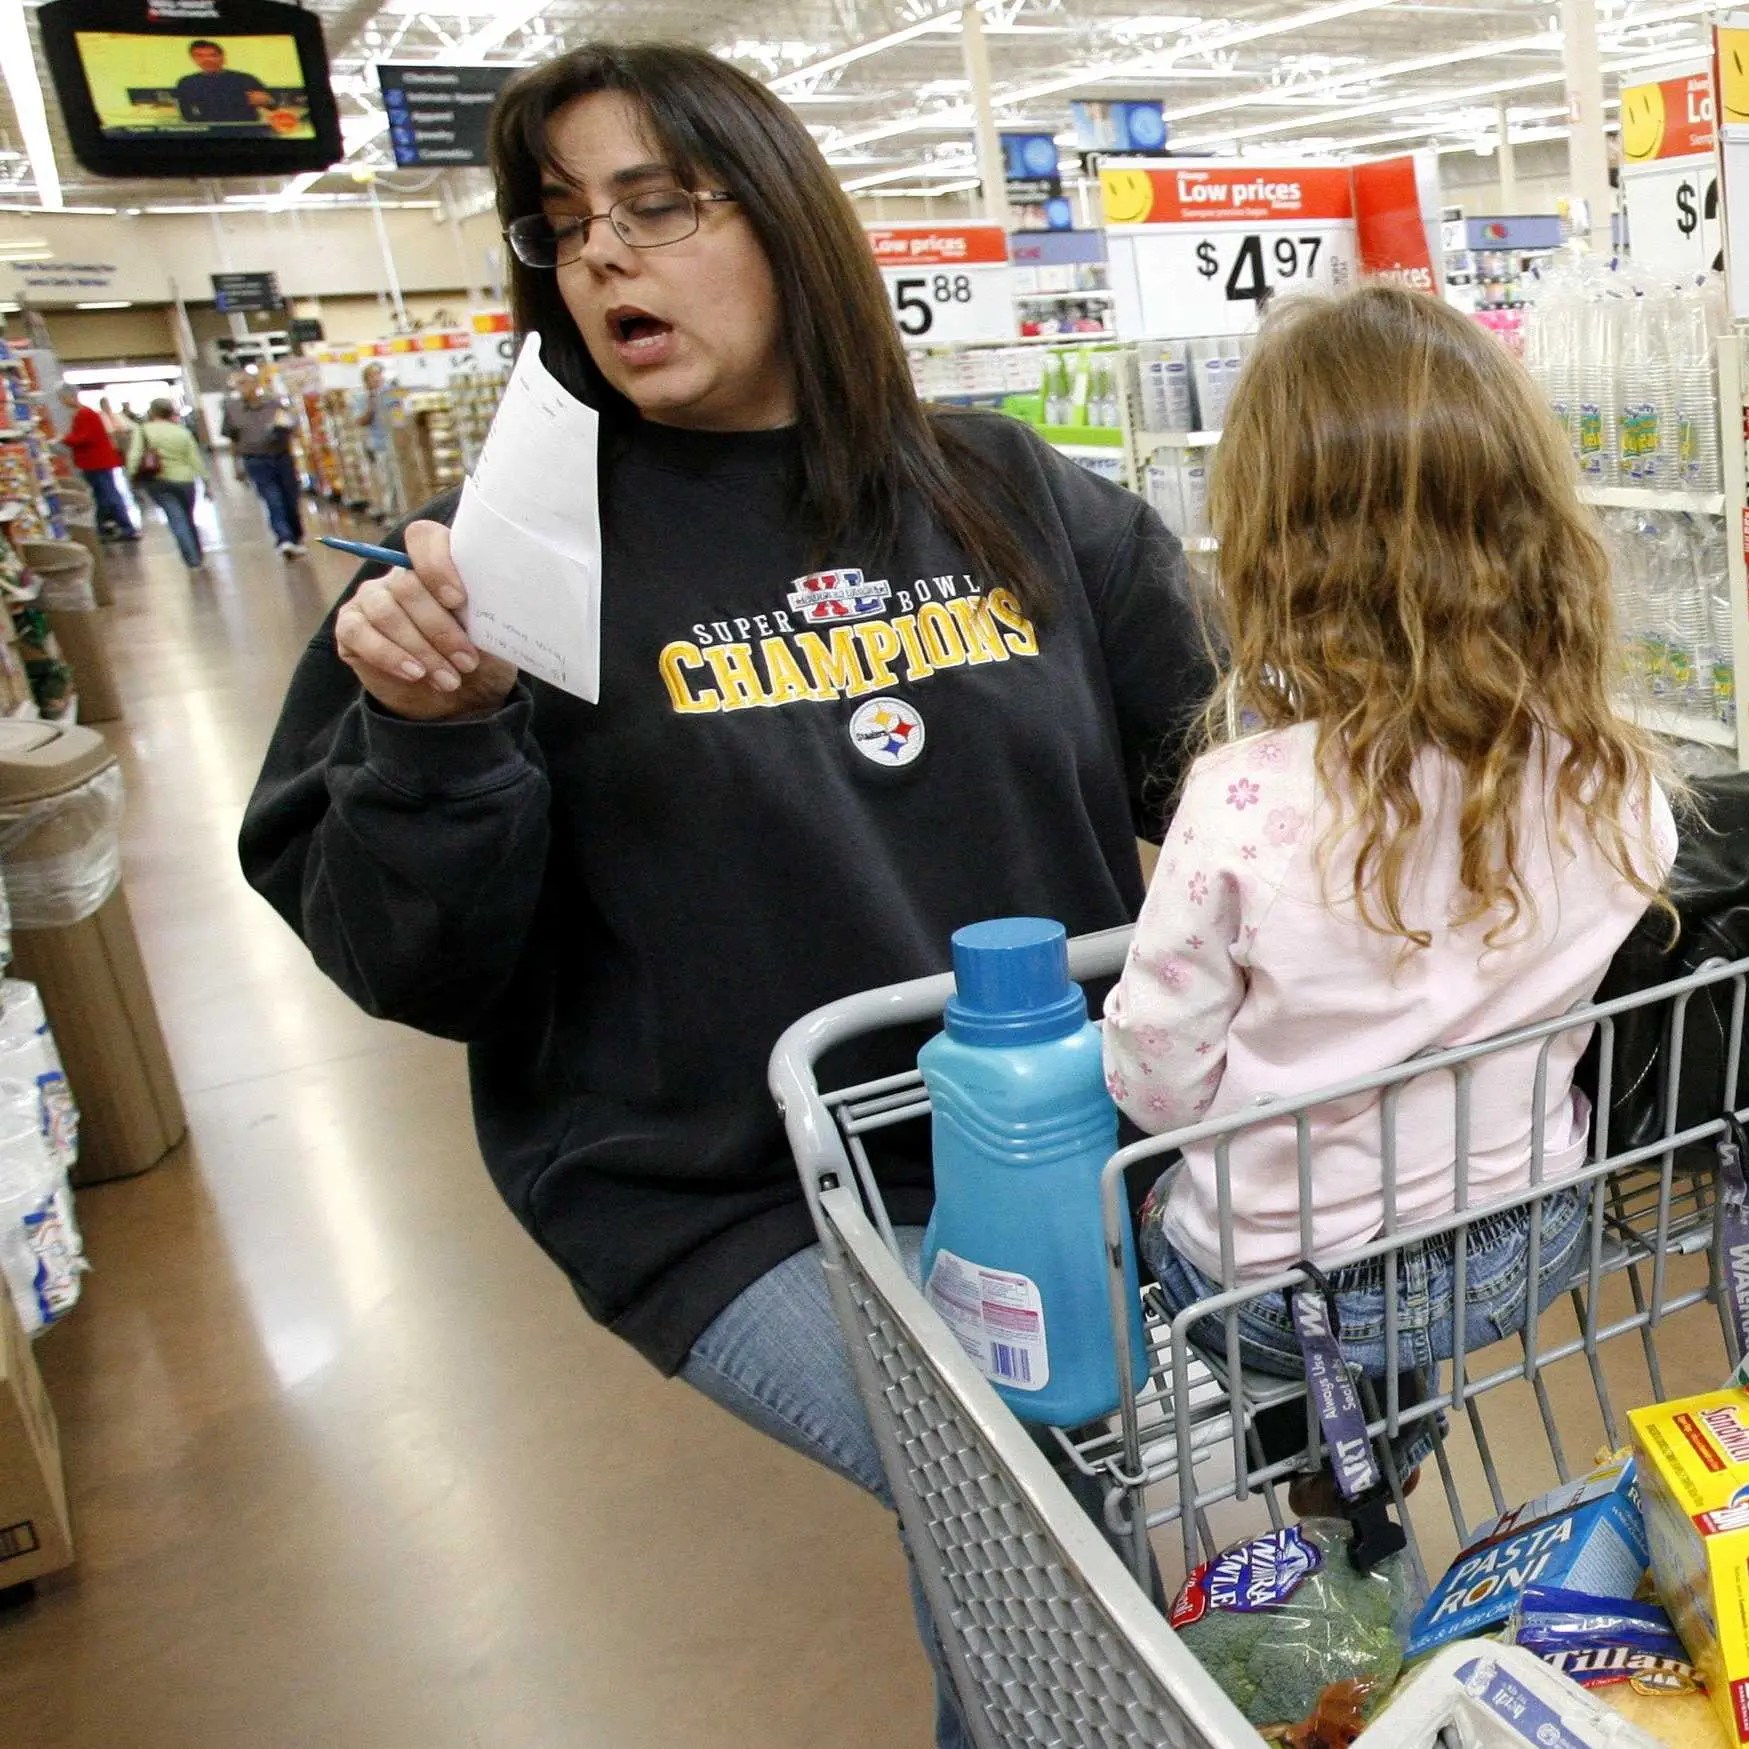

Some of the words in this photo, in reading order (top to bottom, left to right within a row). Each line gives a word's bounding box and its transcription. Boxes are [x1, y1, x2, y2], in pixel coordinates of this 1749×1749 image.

[1687, 93, 1713, 123] Lo
[1178, 179, 1226, 203] Low
[1233, 178, 1301, 205] prices
[693, 609, 795, 645] SUPER
[897, 573, 980, 612] BOWL
[659, 587, 1040, 713] CHAMPIONS
[1312, 1354, 1326, 1377] Use
[1319, 1378, 1338, 1420] Always
[1340, 1386, 1357, 1411] Seat
[1447, 1517, 1574, 1593] PASTA
[1428, 1552, 1552, 1624] RONI
